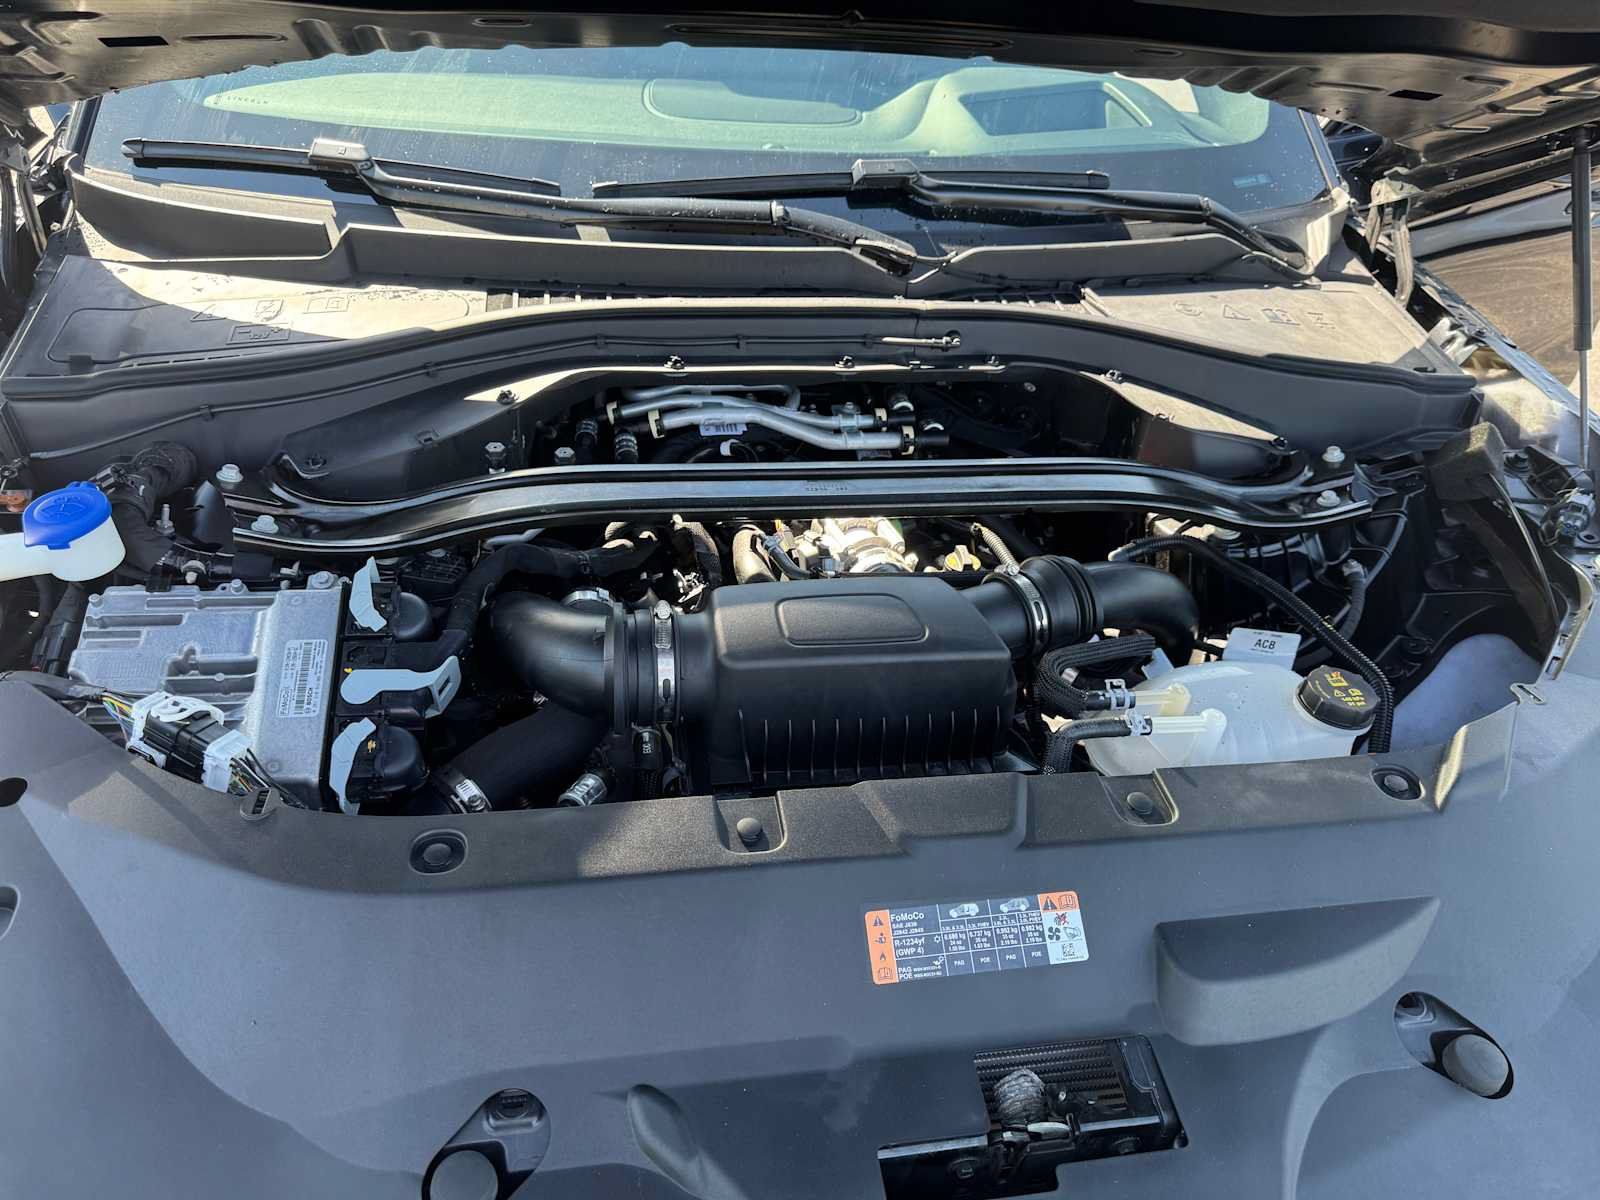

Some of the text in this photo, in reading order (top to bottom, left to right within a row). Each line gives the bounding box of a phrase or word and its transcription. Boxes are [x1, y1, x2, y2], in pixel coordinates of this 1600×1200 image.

[227, 95, 269, 104] LINCOLN
[1254, 638, 1277, 650] ACB
[306, 687, 314, 706] BOSCH
[890, 911, 924, 922] FoMoCo
[983, 928, 991, 937] kg
[1010, 926, 1018, 934] kg
[1035, 923, 1043, 932] kg
[958, 931, 966, 939] kg
[894, 936, 926, 948] R-1234yf
[895, 946, 924, 957] (GWP 4)
